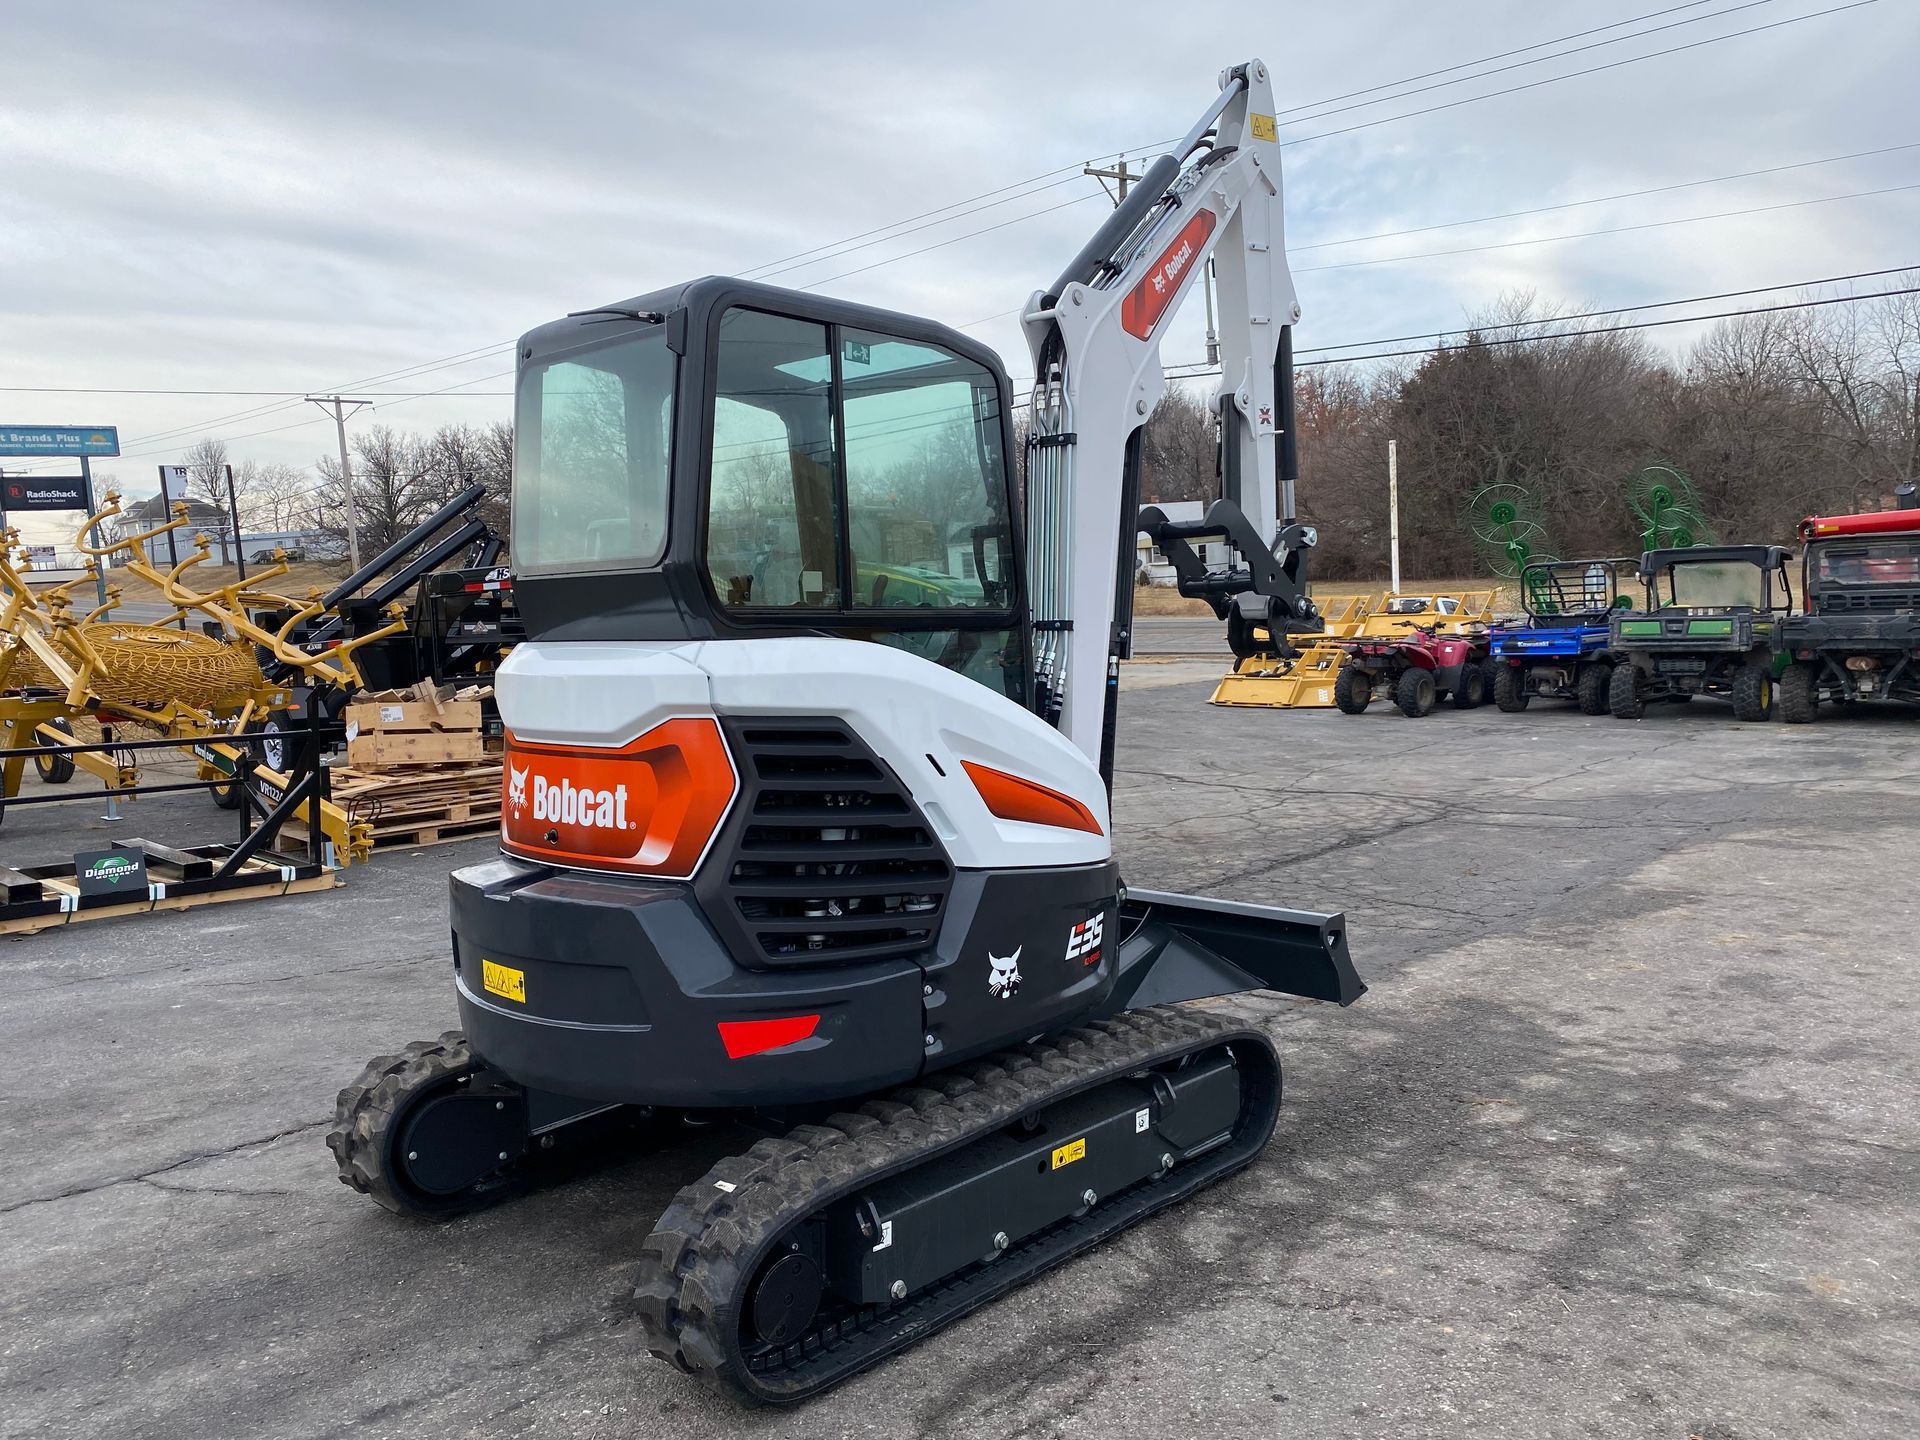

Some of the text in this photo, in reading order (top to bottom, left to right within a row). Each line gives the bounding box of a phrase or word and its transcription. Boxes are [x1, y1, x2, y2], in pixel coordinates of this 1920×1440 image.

[1165, 240, 1192, 280] Bobcat
[10, 433, 52, 442] Brands
[56, 433, 80, 442] Plus
[533, 775, 628, 830] Bobcat
[84, 861, 139, 878] Diamond
[1065, 911, 1104, 961] E35
